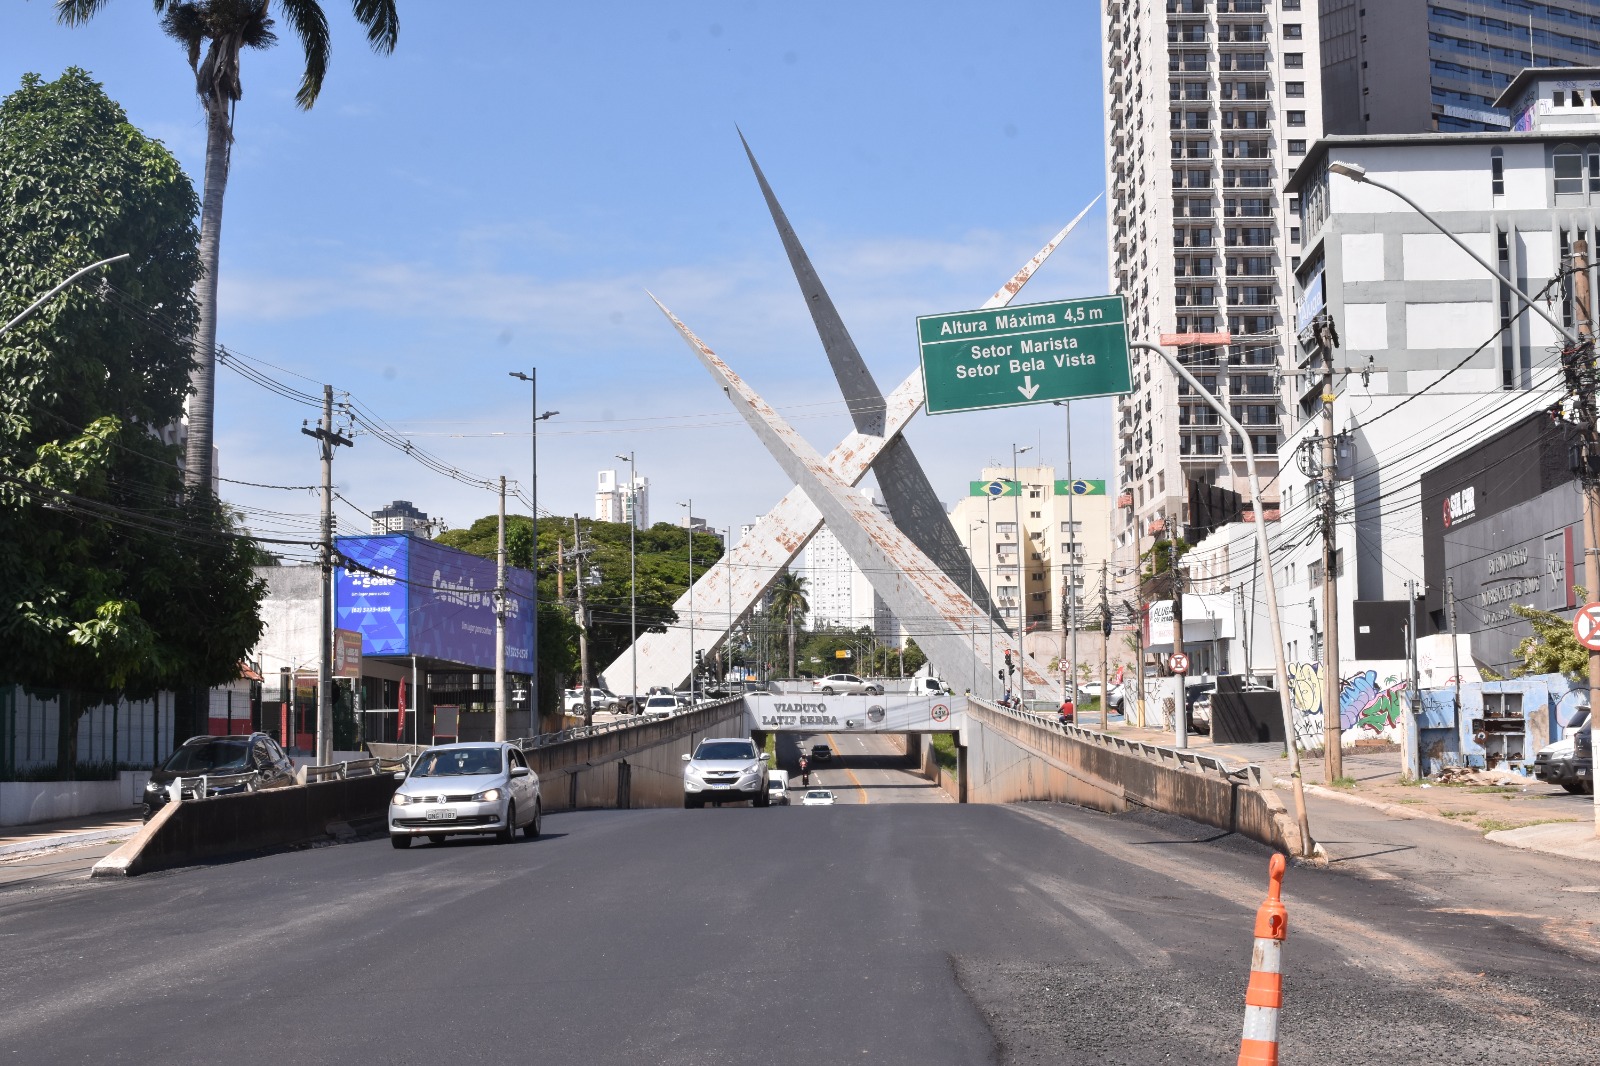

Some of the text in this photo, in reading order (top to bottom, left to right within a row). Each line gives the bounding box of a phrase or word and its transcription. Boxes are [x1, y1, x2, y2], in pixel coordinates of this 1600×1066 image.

[940, 307, 1103, 336] Altura Máxima 4,5 m
[971, 336, 1078, 359] Setor Marista
[956, 352, 1096, 379] Setor Bela Vista
[773, 703, 827, 713] VIADUTO
[762, 716, 797, 725] LATIF
